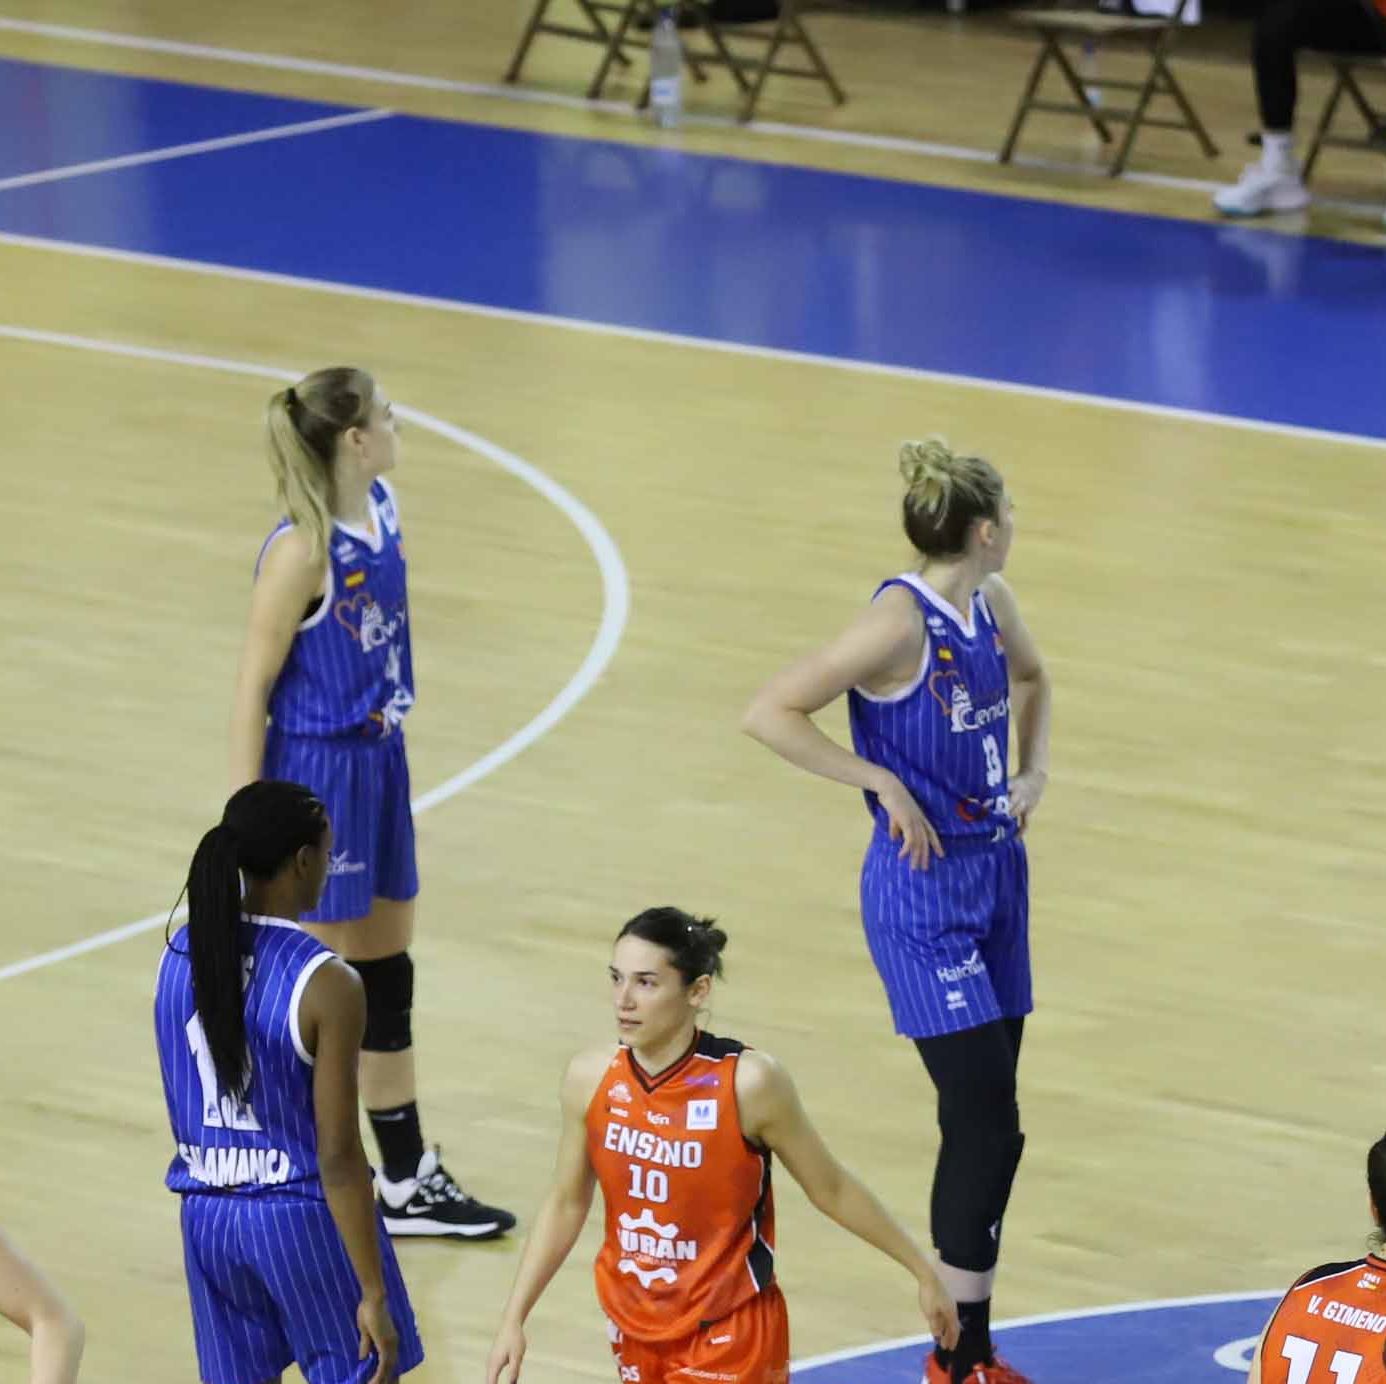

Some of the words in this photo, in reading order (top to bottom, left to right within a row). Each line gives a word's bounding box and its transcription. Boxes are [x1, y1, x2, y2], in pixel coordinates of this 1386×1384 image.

[605, 1121, 703, 1168] ENSINO
[628, 1163, 670, 1204] 10
[616, 1228, 697, 1260] URAN
[1306, 1295, 1323, 1315] V.
